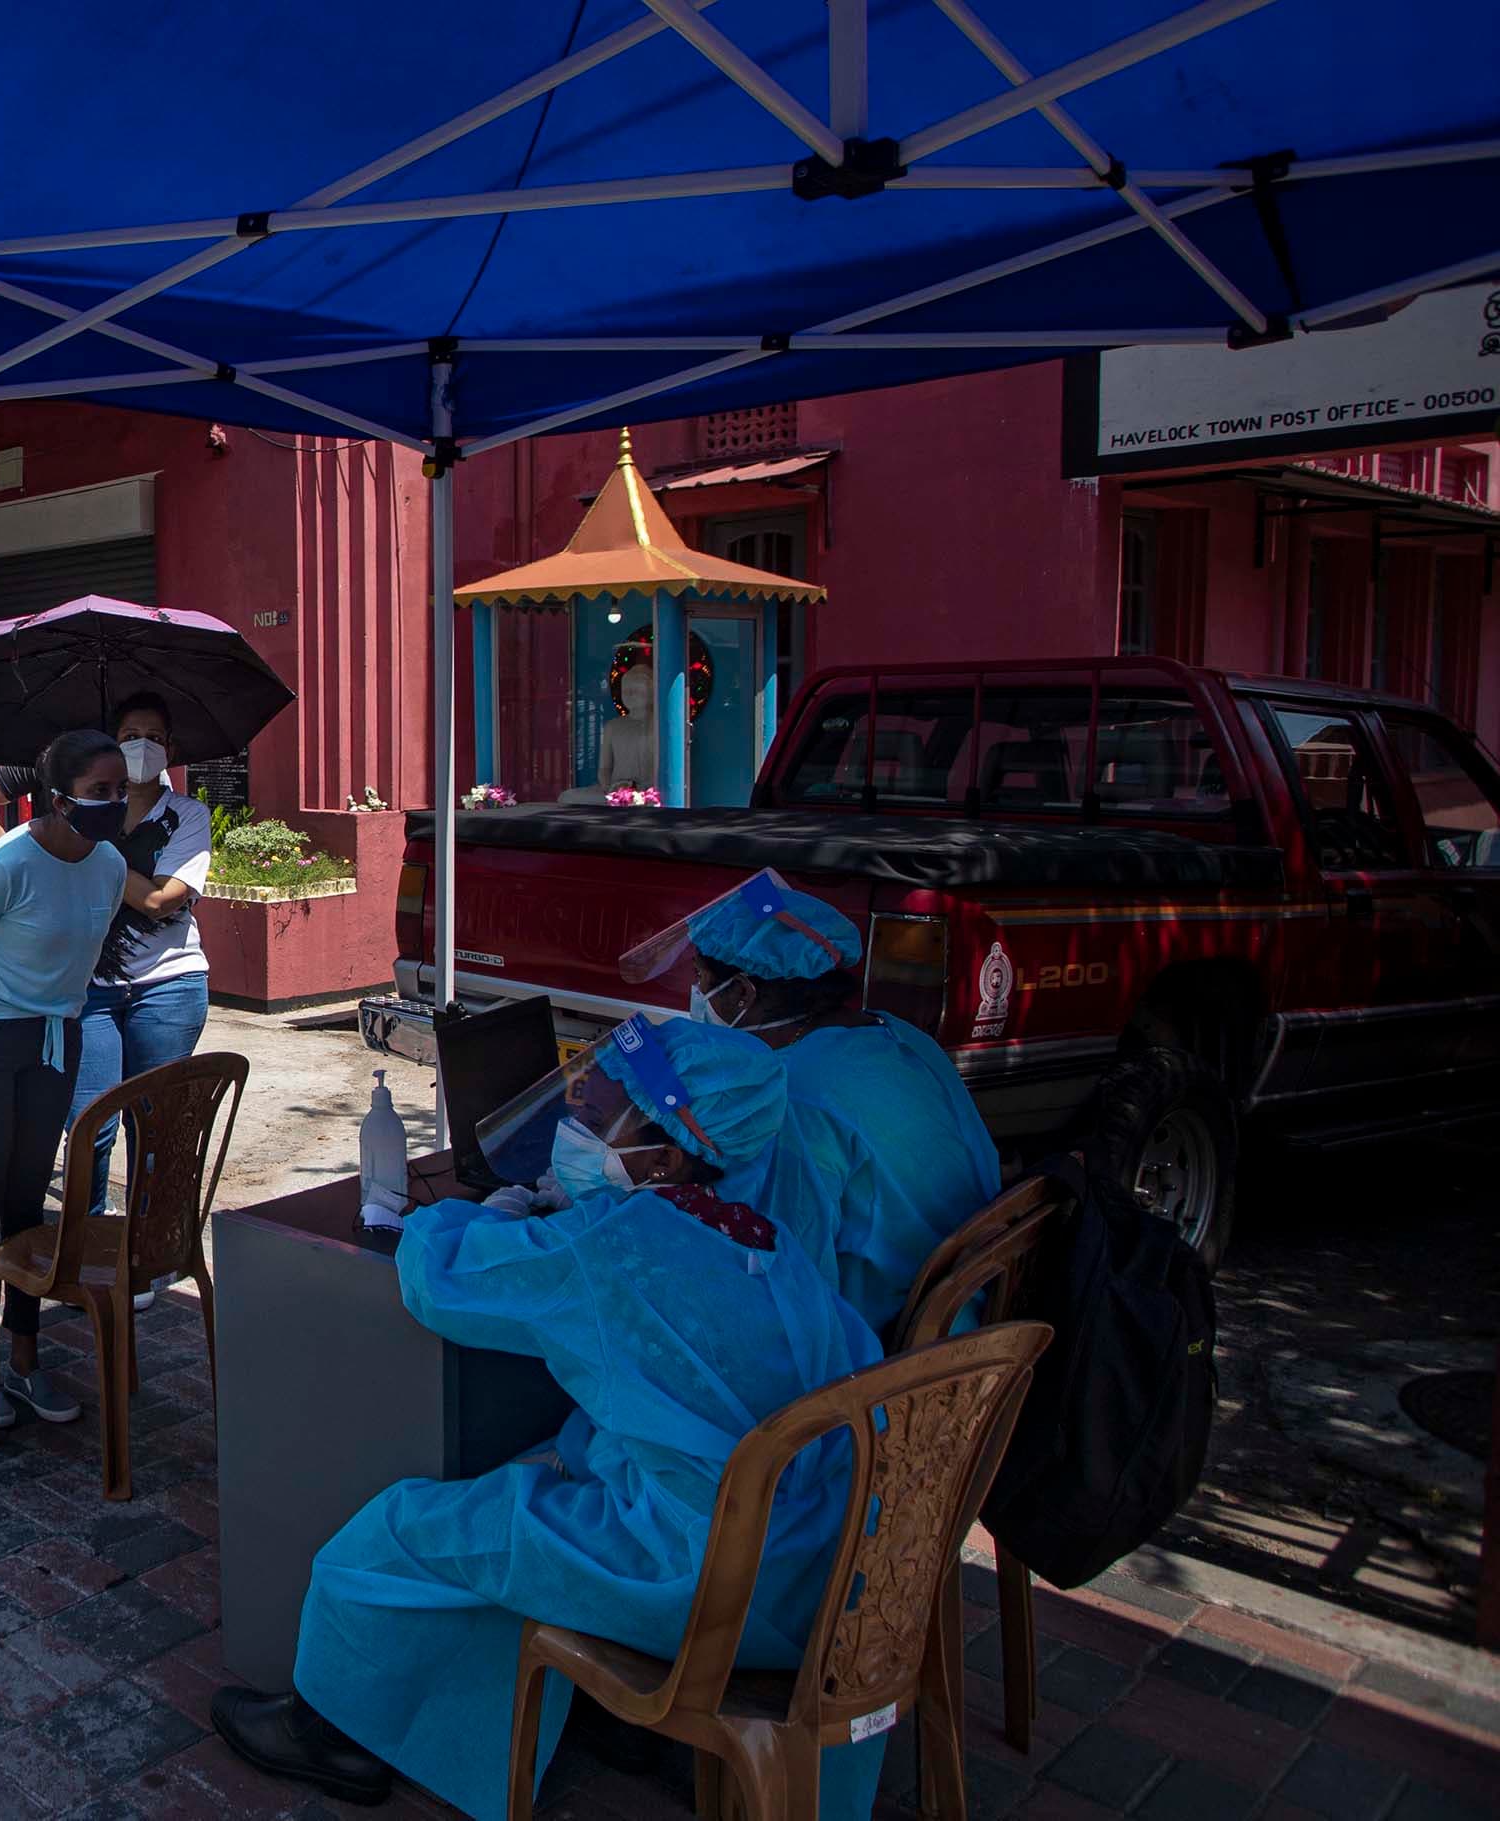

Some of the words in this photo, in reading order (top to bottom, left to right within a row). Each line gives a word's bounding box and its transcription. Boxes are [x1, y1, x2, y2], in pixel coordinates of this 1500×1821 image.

[1110, 423, 1200, 449] HAVELOCK
[1207, 415, 1263, 436] TOWN
[1270, 408, 1321, 430] POST
[1327, 399, 1399, 422] OFFICE
[1423, 387, 1495, 411] 00500
[1016, 962, 1109, 991] L200
